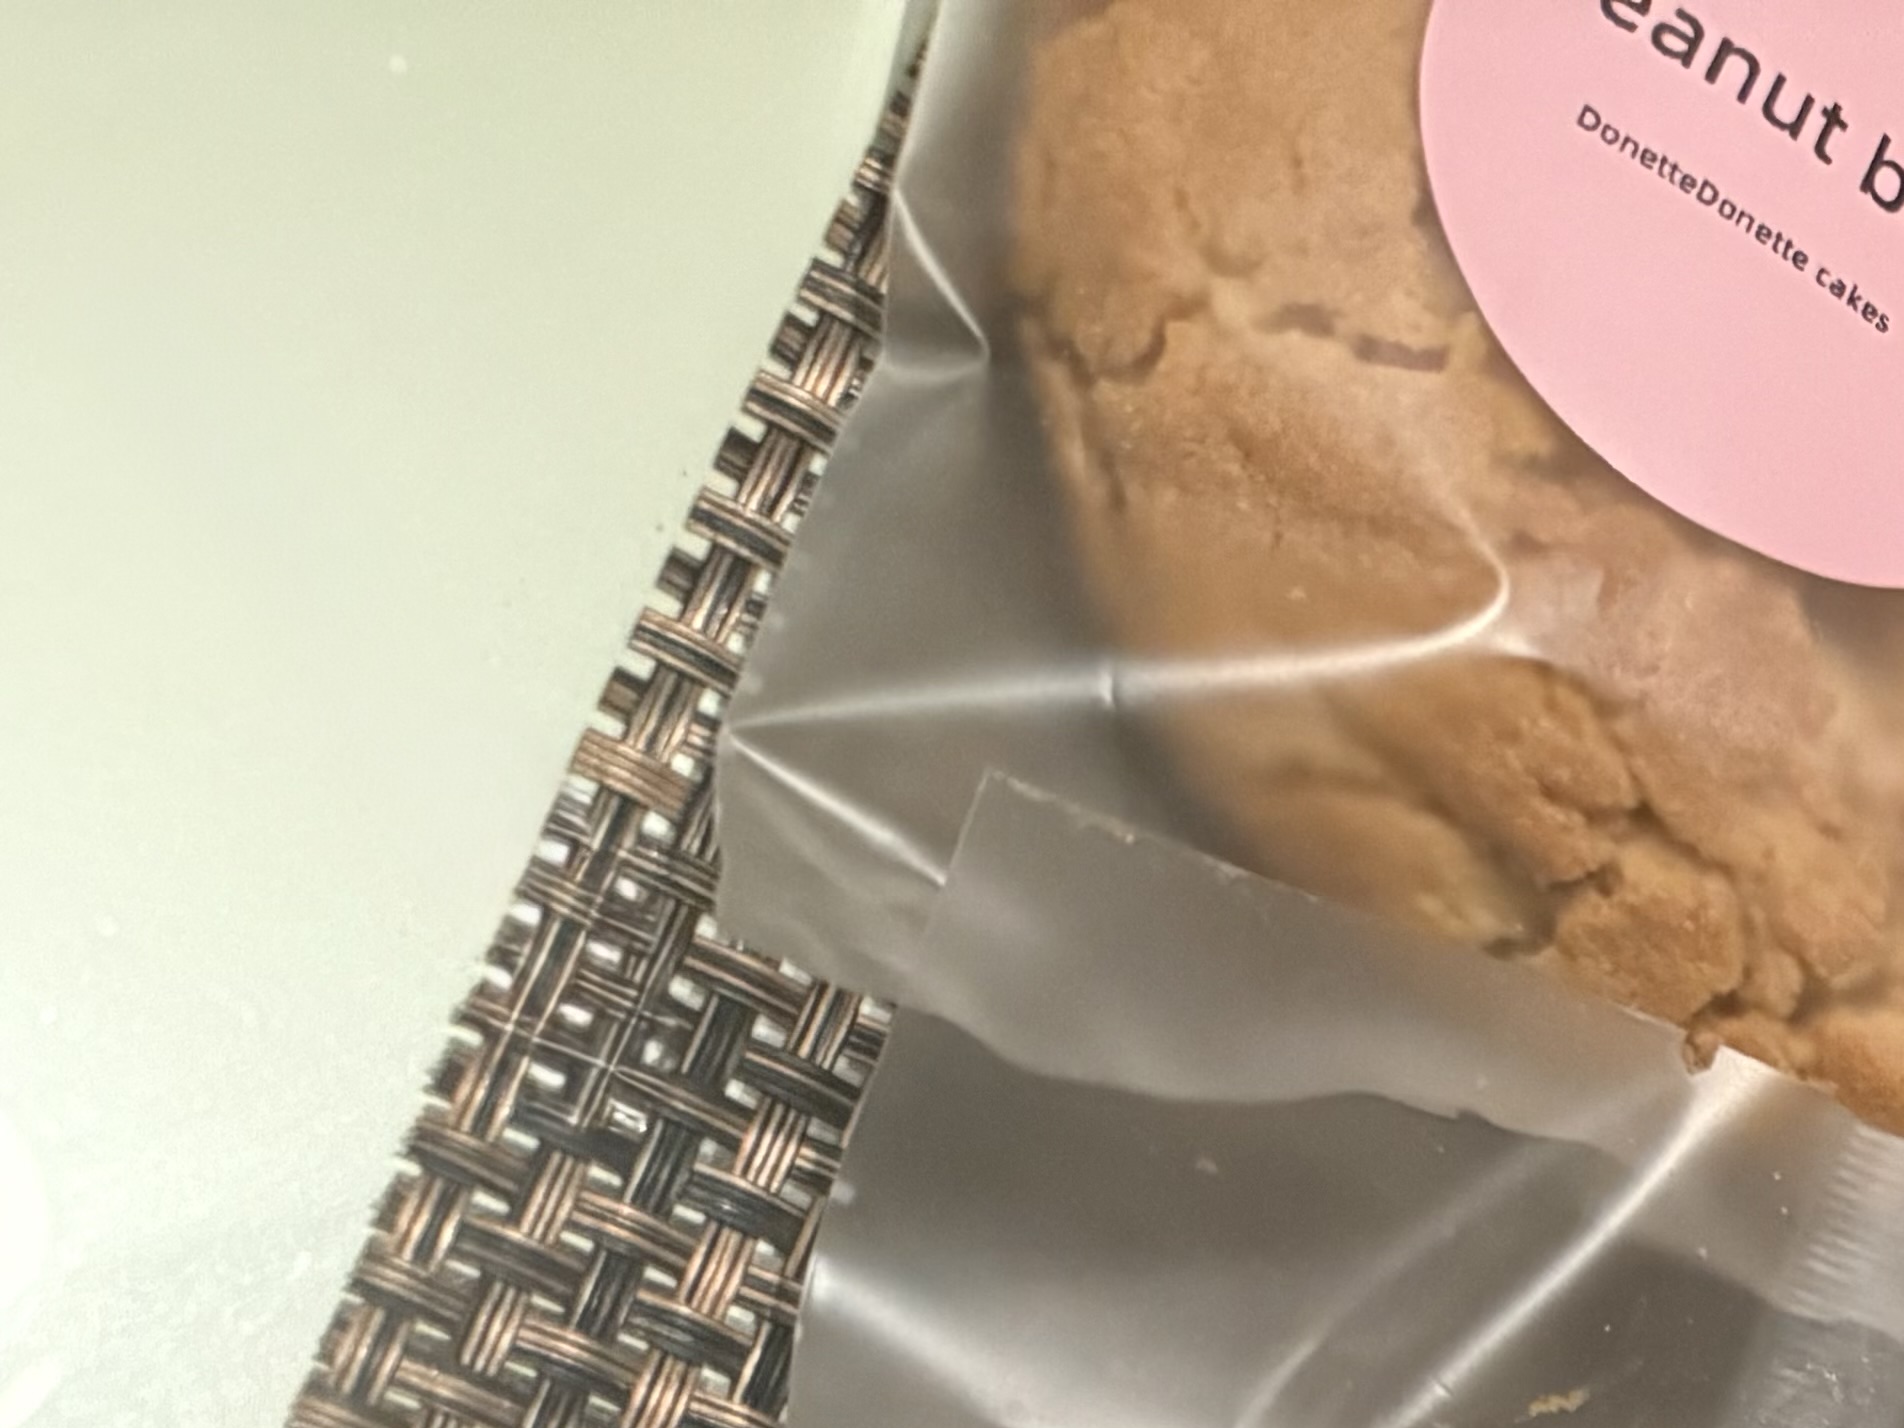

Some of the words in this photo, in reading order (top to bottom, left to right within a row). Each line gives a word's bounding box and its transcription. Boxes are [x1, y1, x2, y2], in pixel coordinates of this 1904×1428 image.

[1600, 0, 1848, 165] eanut
[1577, 104, 1808, 271] DonetteDonette
[1816, 268, 1889, 333] cakes
